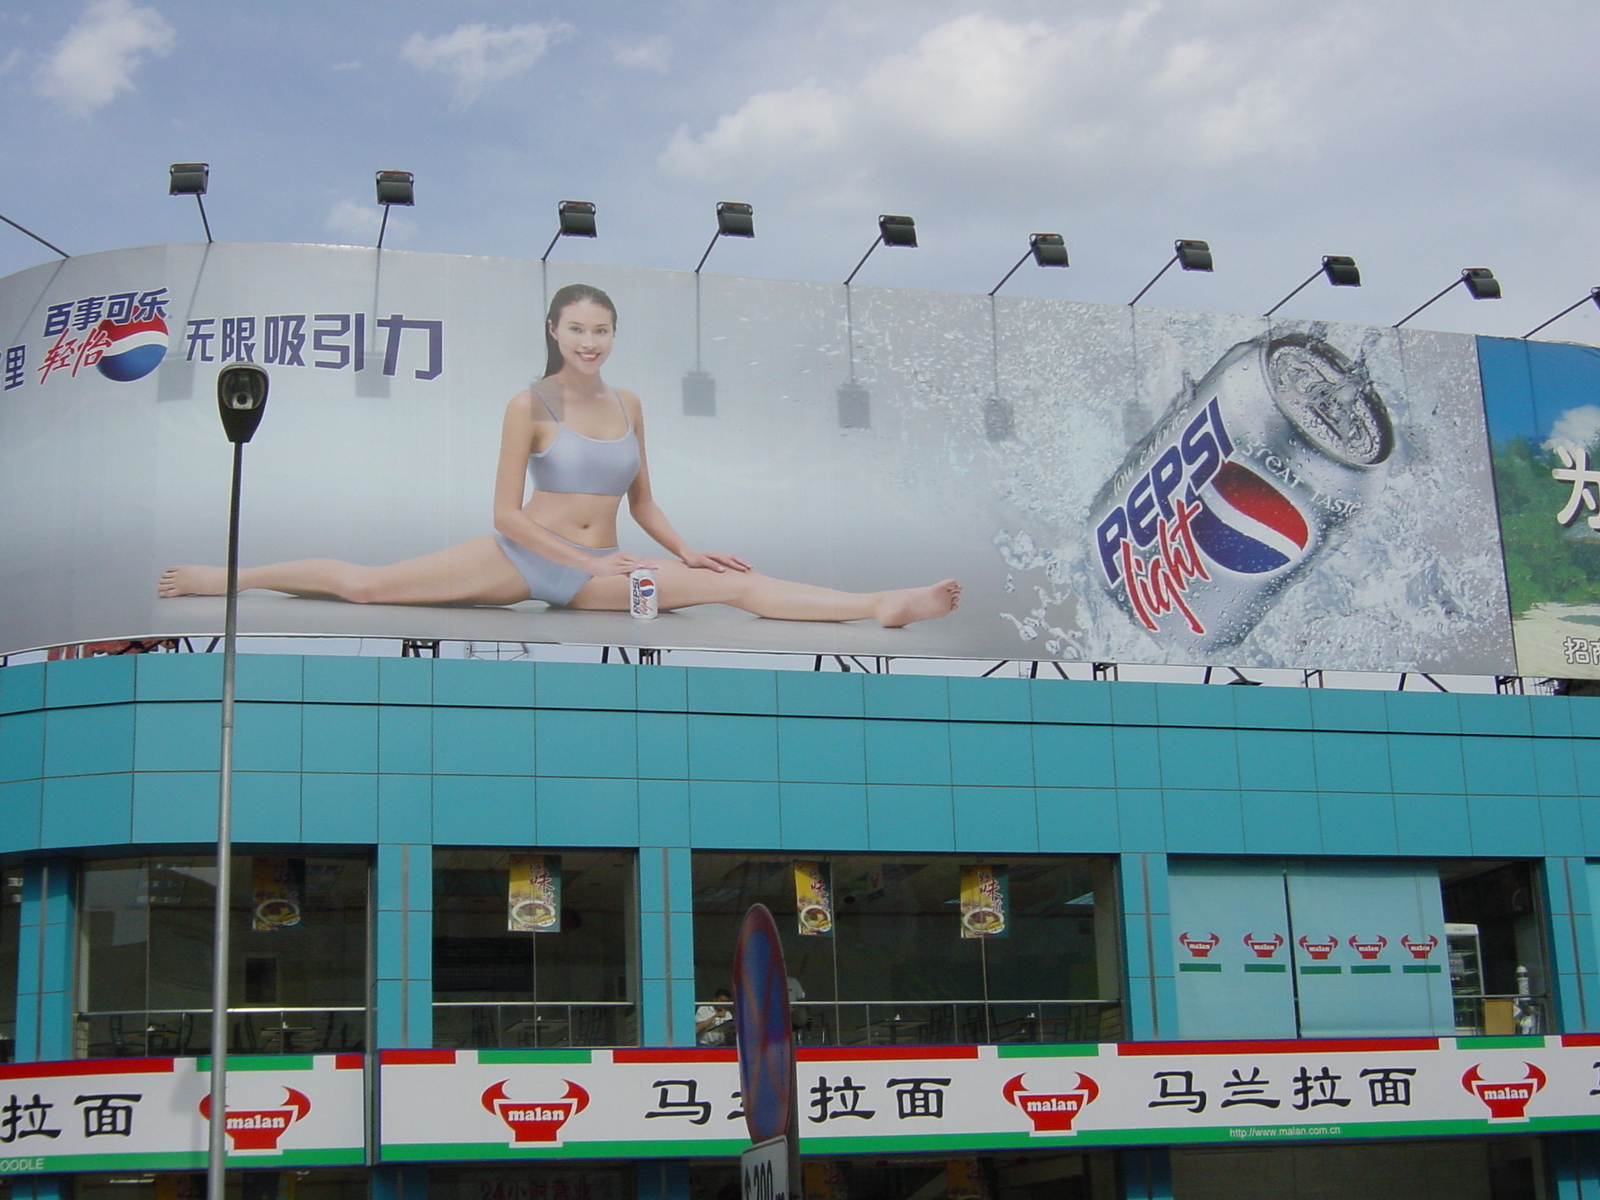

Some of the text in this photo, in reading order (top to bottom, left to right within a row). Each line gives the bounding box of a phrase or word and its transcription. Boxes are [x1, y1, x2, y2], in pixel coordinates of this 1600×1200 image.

[43, 286, 171, 338] 百事可乐
[0, 344, 26, 392] 里
[37, 327, 112, 386] 轻怡
[184, 312, 443, 381] 无限吸引力
[1096, 395, 1235, 588] PEPSI
[1121, 498, 1211, 634] light
[632, 577, 641, 614] PEPSI
[1027, 1098, 1077, 1112] malan
[1148, 1066, 1417, 1114] 马兰拉面
[1484, 1087, 1528, 1100] malan
[0, 1094, 142, 1143] 拉面
[226, 1114, 285, 1129] malan
[508, 1107, 564, 1122] malan
[1229, 1126, 1341, 1139] http://www.malan.com.cn
